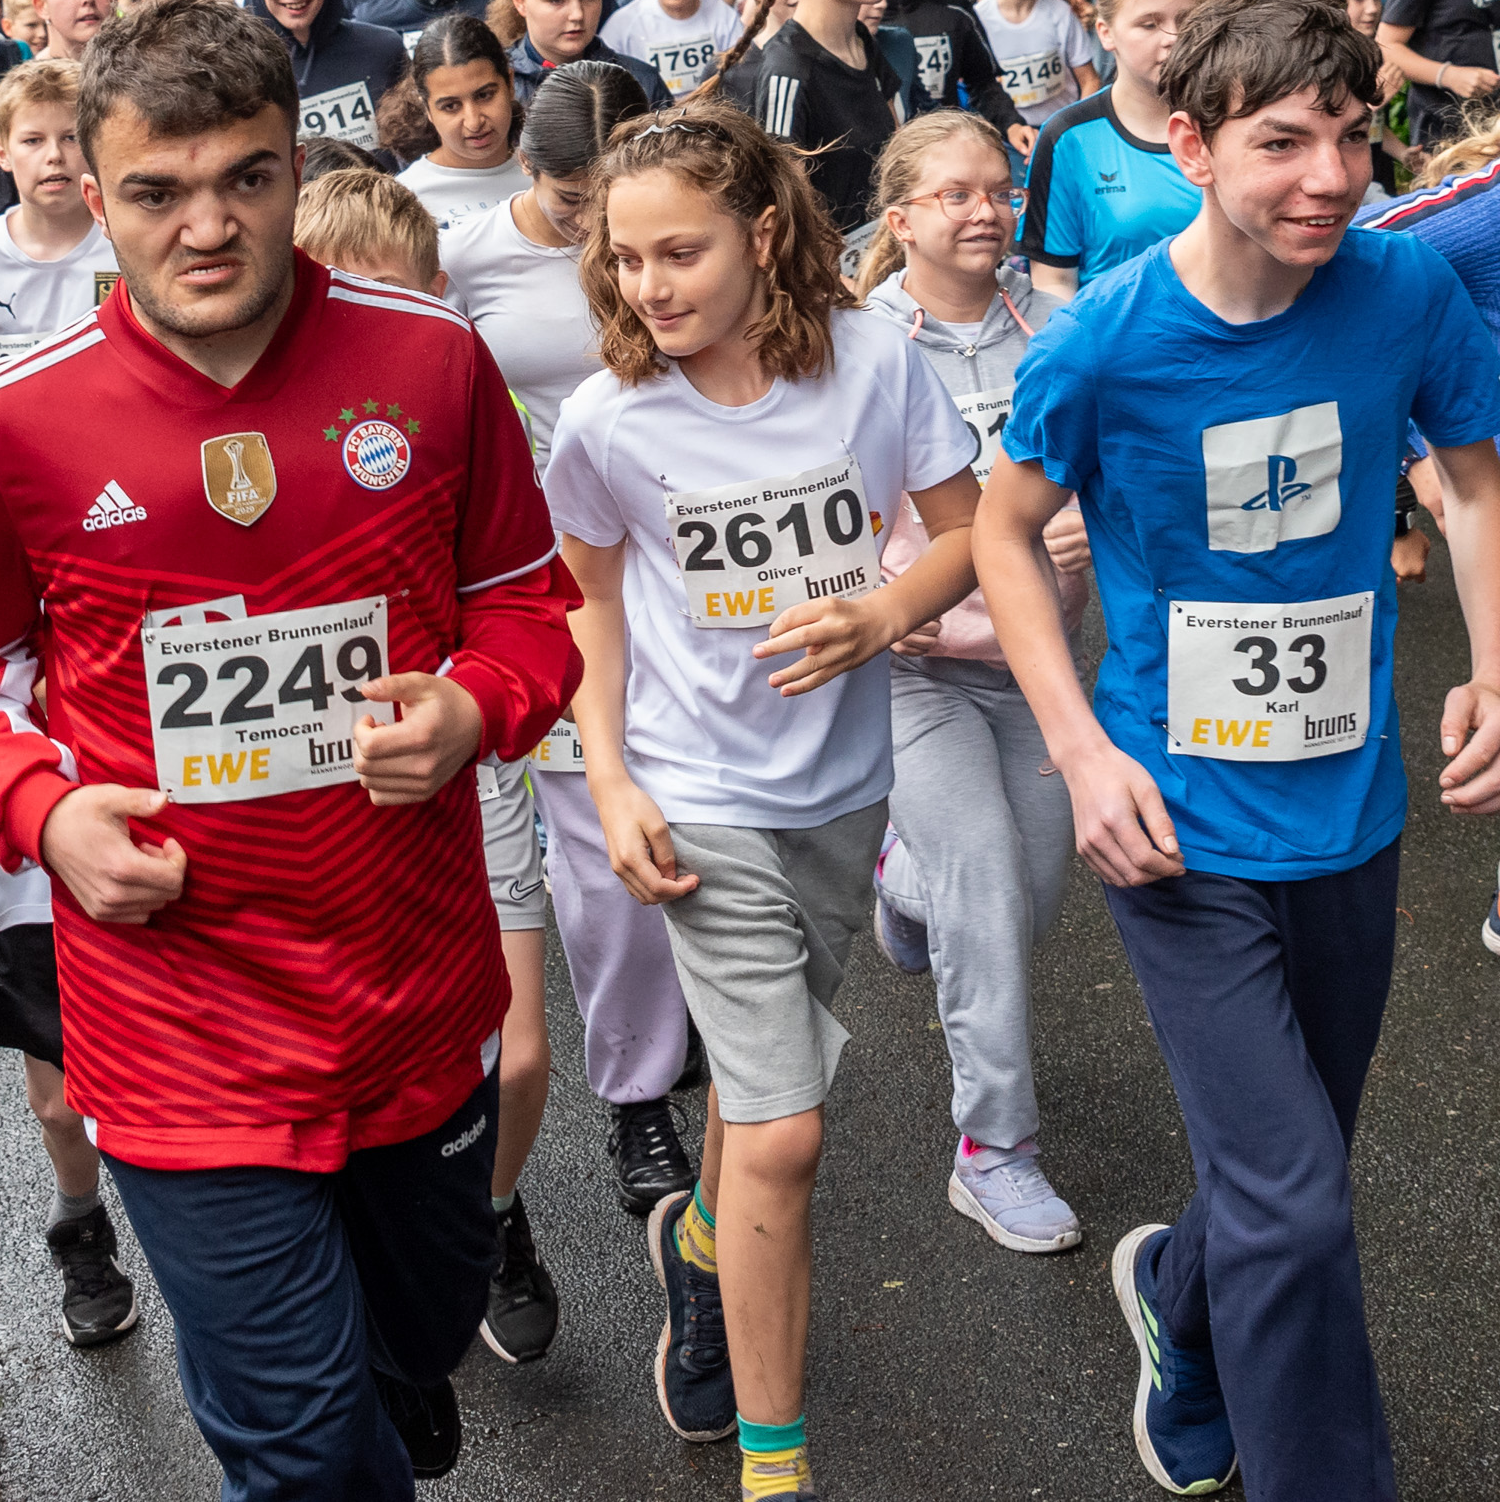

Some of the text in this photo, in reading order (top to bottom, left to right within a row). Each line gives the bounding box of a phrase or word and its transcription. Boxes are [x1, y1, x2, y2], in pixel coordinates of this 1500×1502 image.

[649, 44, 715, 73] 1768
[1004, 56, 1062, 89] 2146
[303, 95, 372, 136] 914
[1094, 184, 1127, 195] erima
[347, 424, 405, 453] FC BAYERN
[226, 488, 260, 504] FIFA
[675, 468, 851, 516] Everstener Brunnenlauf
[82, 504, 148, 533] adidas
[676, 488, 864, 572] 2610
[757, 565, 804, 583] Oliver
[804, 566, 867, 601] bruns
[705, 586, 776, 618] EWE
[1186, 605, 1364, 630] Everstener Brunnenlauf
[160, 611, 375, 656] Everstener Brunnenlauf
[1231, 633, 1328, 697] 33
[155, 635, 383, 730] 2249
[1265, 700, 1300, 714] Karl
[235, 721, 325, 744] Temocan
[1190, 717, 1273, 748] EWE
[1304, 712, 1357, 741] bruns
[181, 746, 272, 788] EWE
[308, 737, 353, 767] bru
[440, 1113, 487, 1158] adidas
